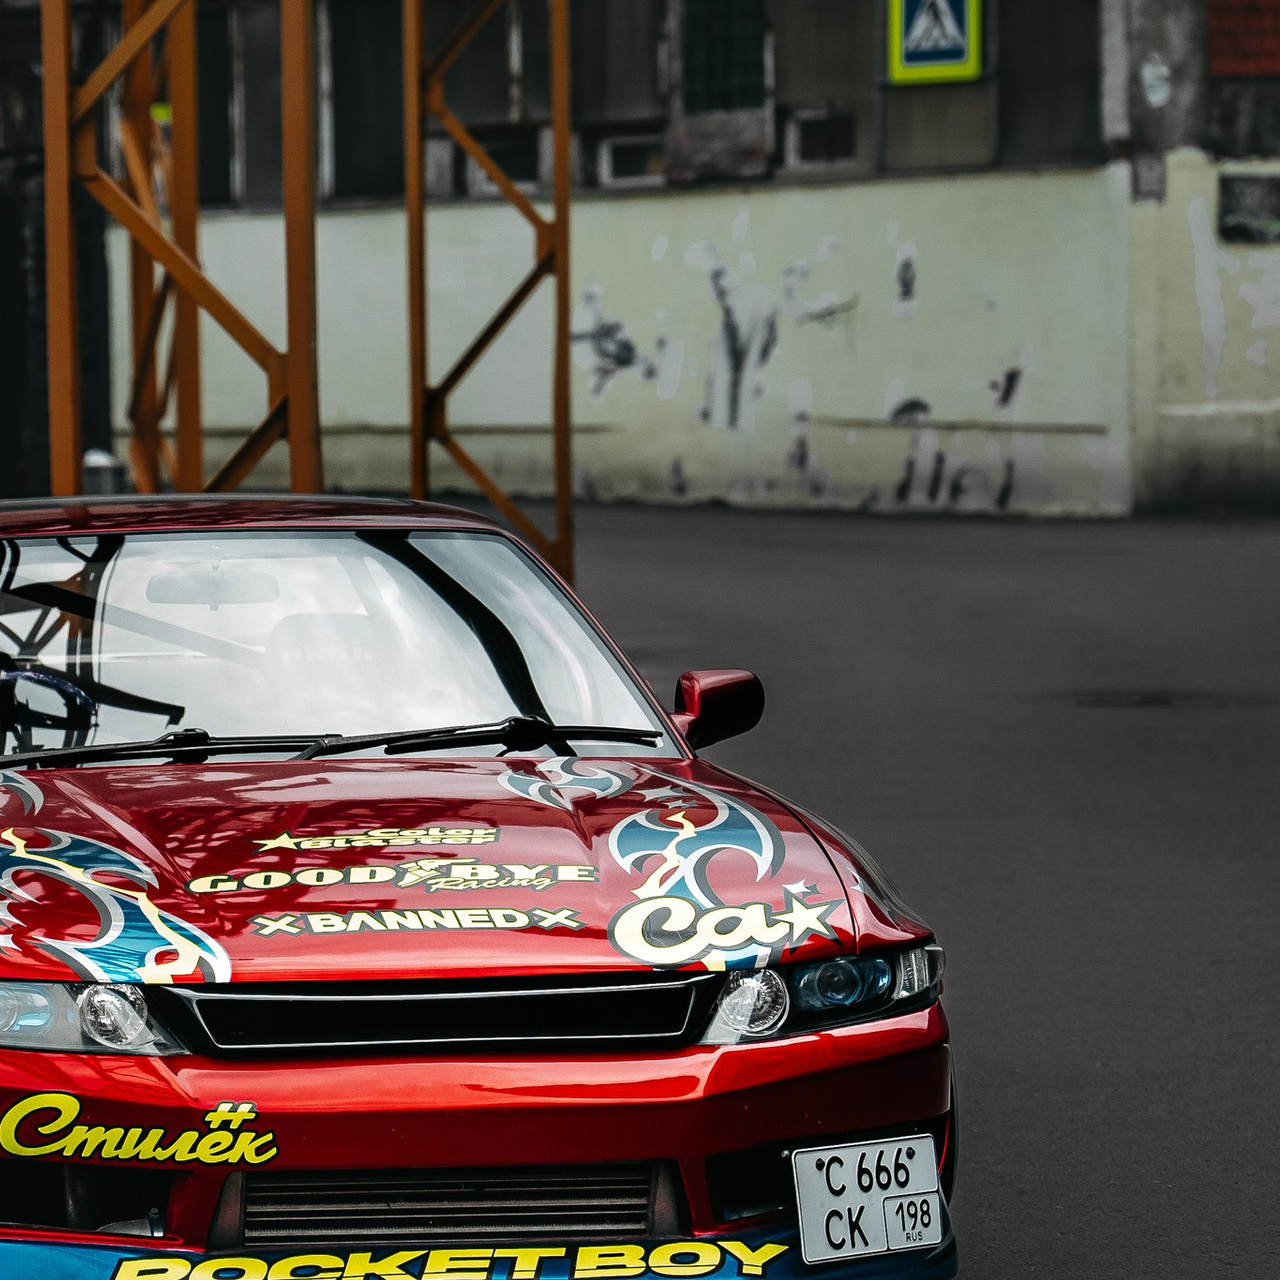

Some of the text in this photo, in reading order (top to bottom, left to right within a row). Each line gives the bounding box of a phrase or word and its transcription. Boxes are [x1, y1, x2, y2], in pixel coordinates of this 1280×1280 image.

[429, 875, 556, 893] Racing
[856, 1147, 910, 1193] 666
[895, 1198, 932, 1232] 198
[905, 1231, 923, 1242] RUS
[573, 1240, 791, 1280] BOY
